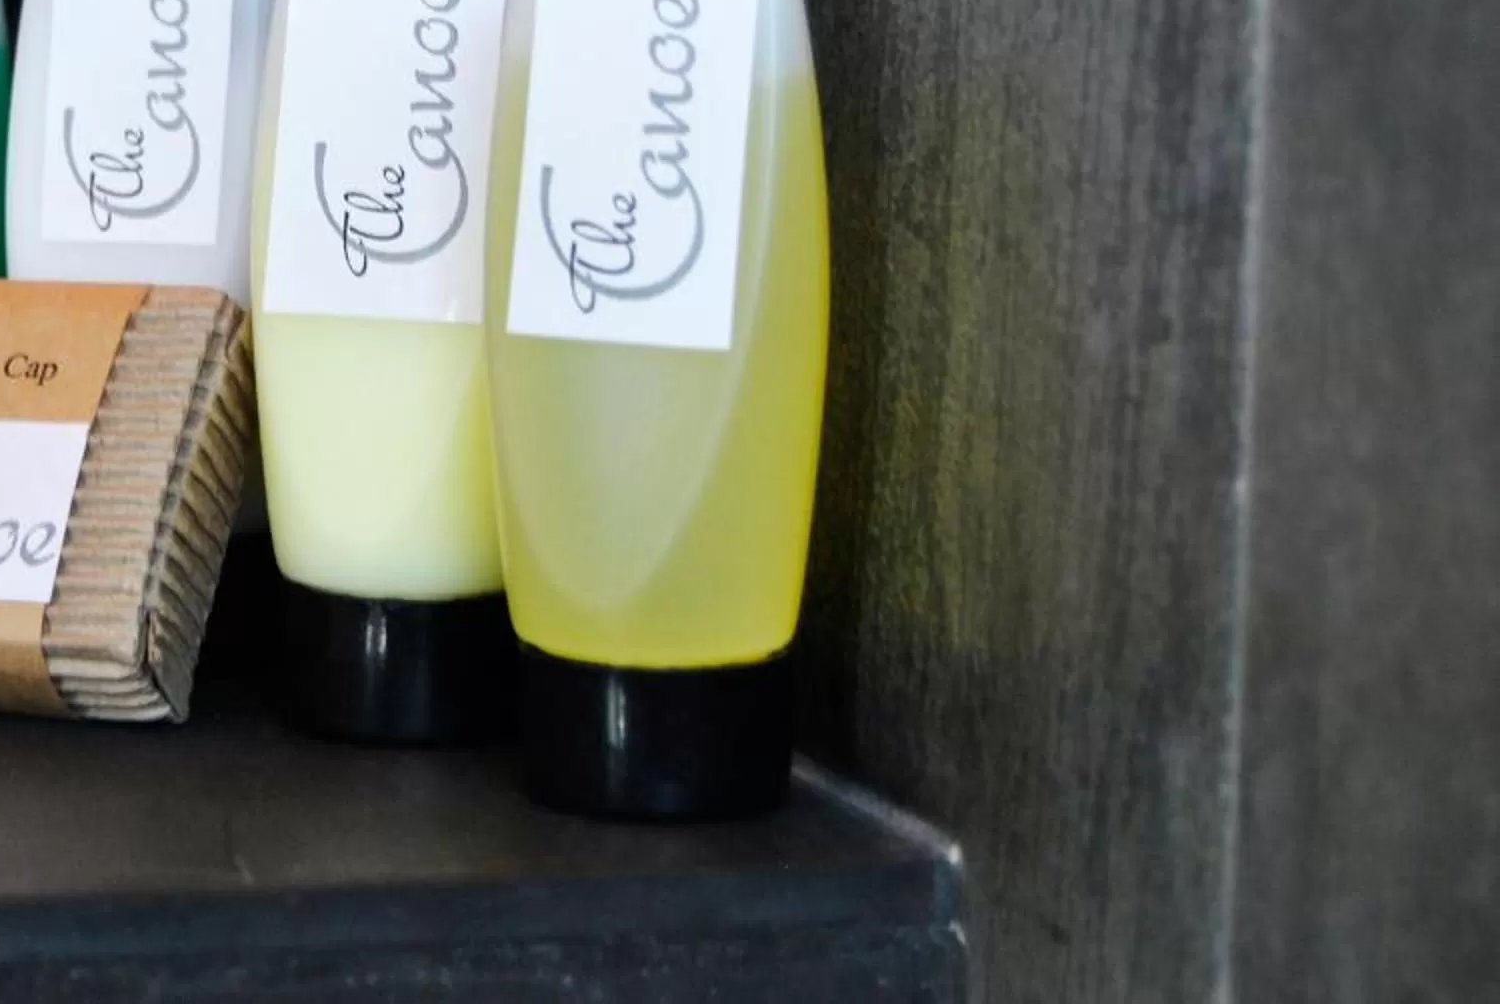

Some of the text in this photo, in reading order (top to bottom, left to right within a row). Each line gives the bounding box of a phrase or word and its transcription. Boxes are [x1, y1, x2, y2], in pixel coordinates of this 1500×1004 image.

[89, 128, 144, 232] The
[343, 165, 404, 276] The
[571, 193, 638, 313] The
[4, 353, 58, 385] Cap
